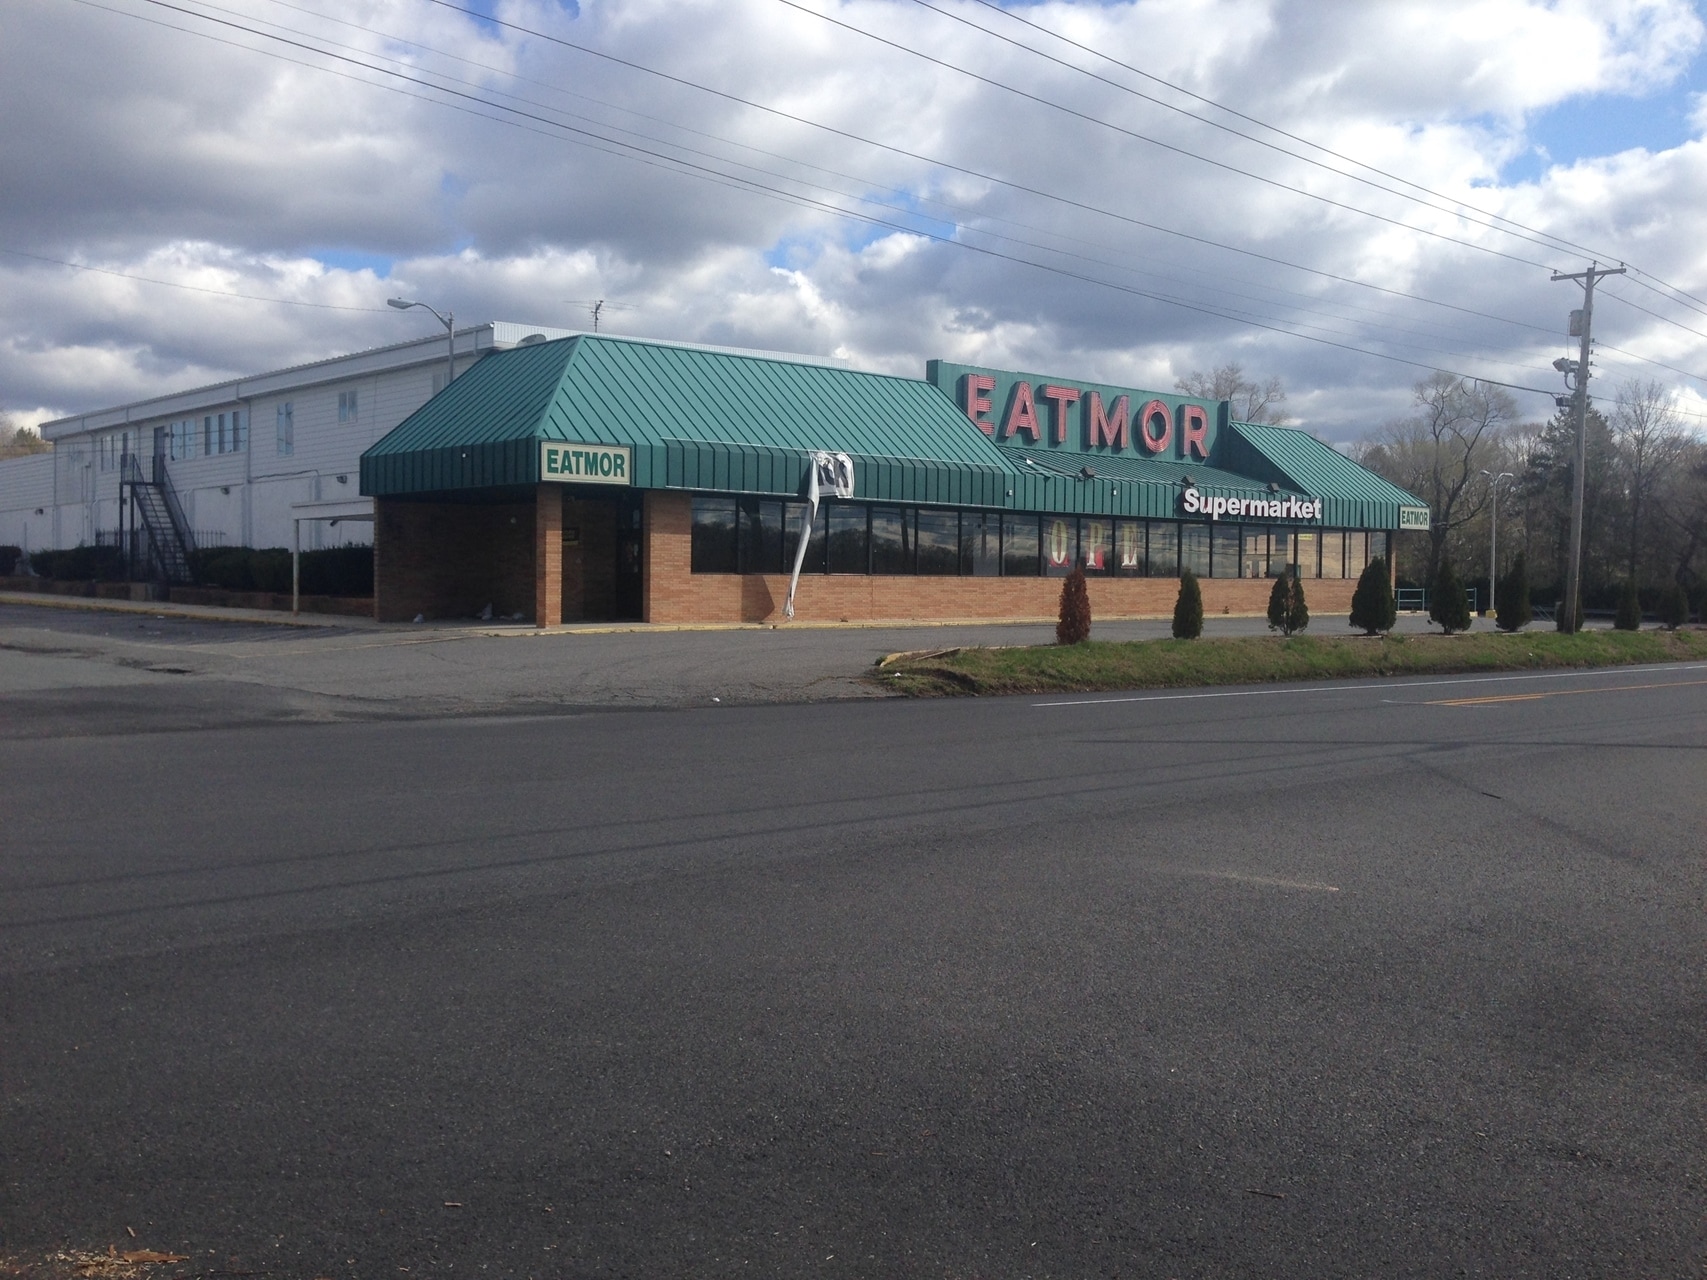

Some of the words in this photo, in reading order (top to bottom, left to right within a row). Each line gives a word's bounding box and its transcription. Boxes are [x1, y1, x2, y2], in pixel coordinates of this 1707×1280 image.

[964, 374, 1210, 458] EATMOR
[547, 449, 625, 477] EATMOR
[1183, 488, 1322, 520] Supermarket
[1401, 510, 1429, 526] EATMOR
